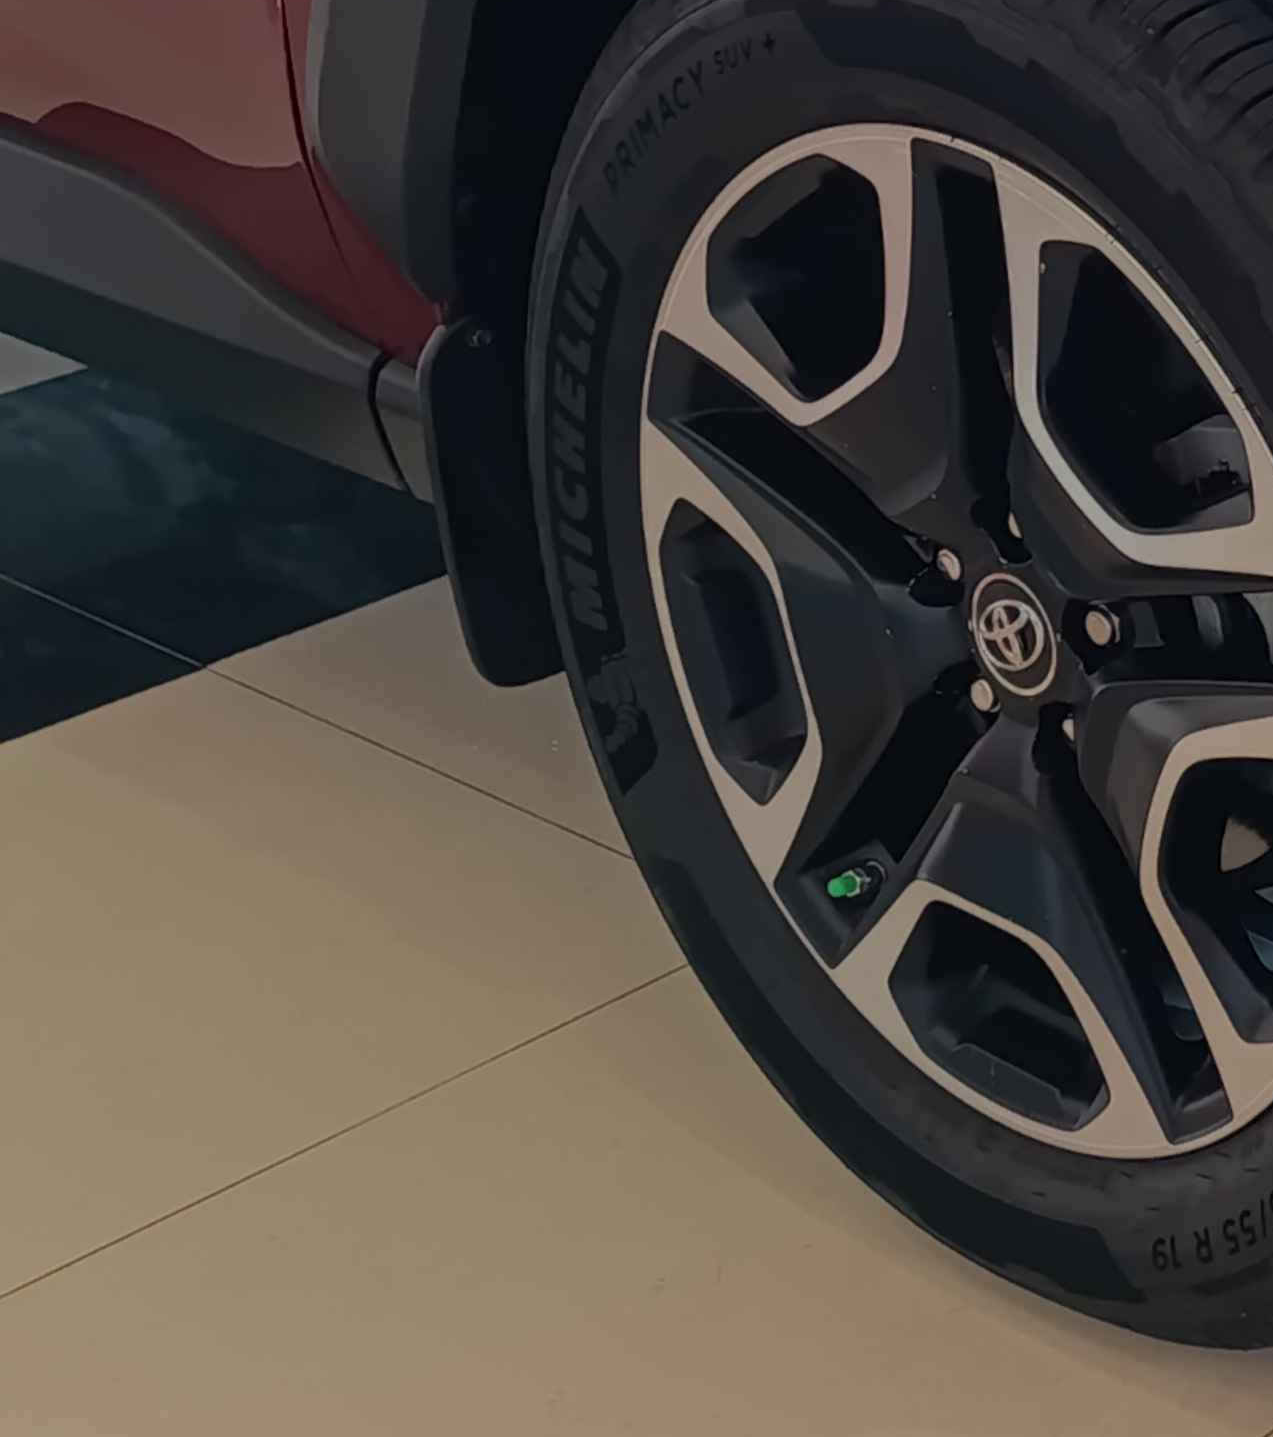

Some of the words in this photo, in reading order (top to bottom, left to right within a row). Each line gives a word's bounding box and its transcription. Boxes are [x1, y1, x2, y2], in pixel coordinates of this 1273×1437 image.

[603, 60, 706, 199] PRIMACY
[713, 35, 753, 76] SUV
[551, 235, 610, 633] MICHELIN
[1152, 1235, 1183, 1272] 19
[1193, 1227, 1215, 1264] R
